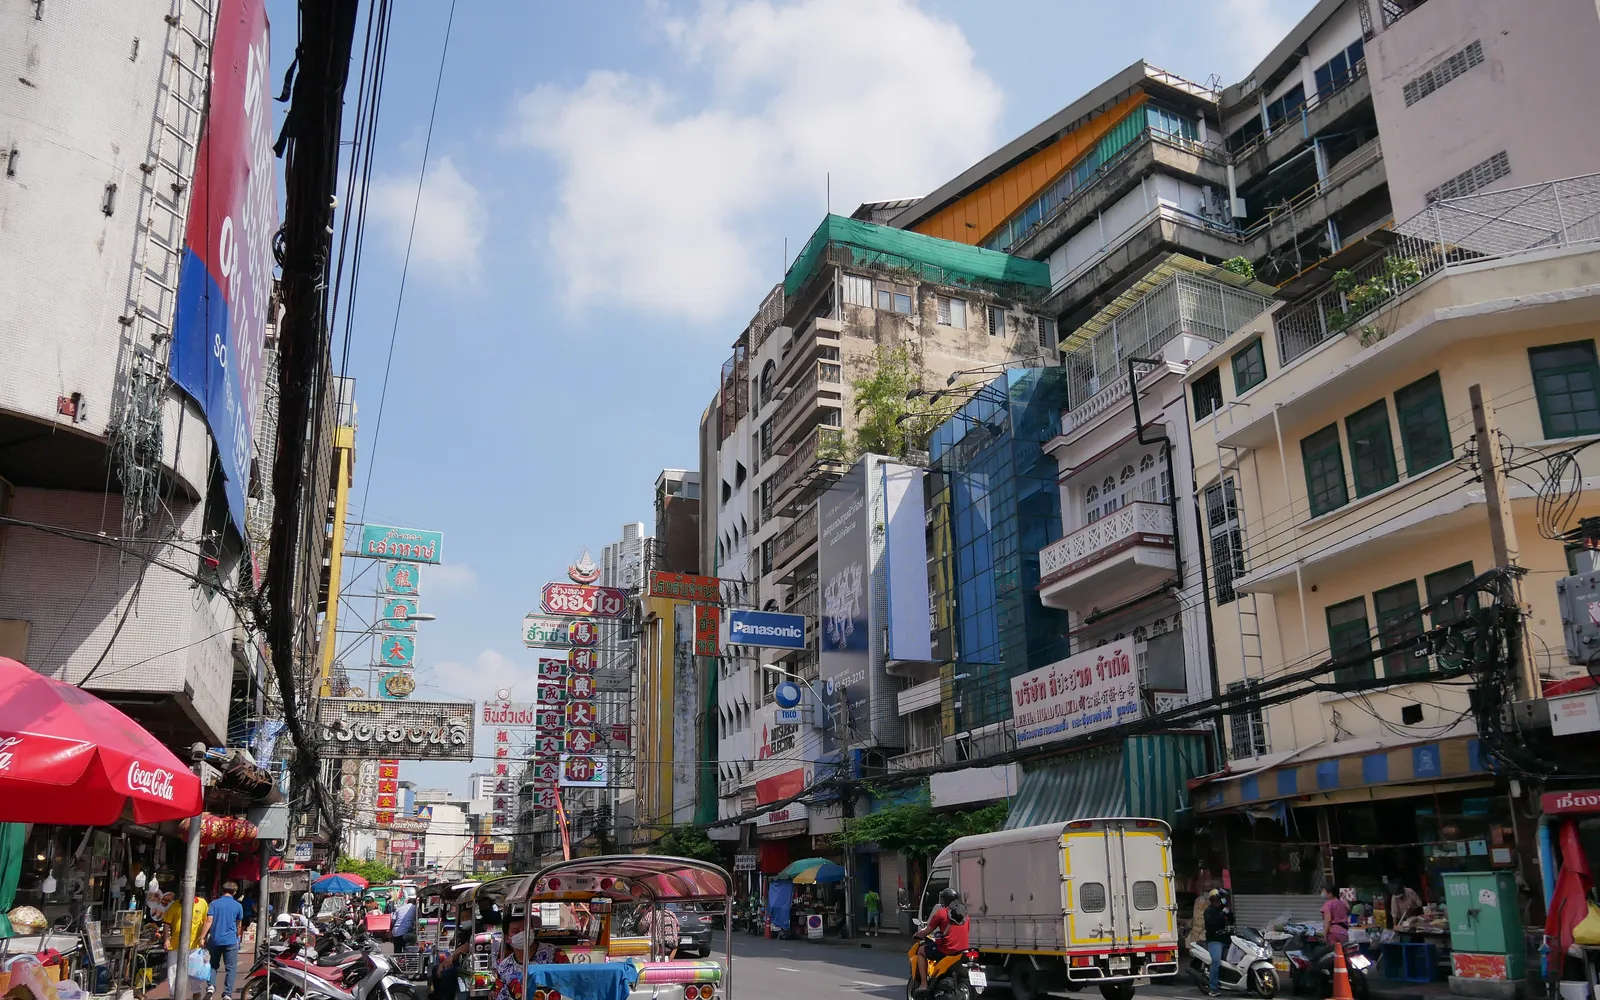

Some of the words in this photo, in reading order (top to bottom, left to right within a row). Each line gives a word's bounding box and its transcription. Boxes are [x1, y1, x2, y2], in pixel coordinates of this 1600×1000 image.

[651, 572, 719, 599] โรงรับจำนำ
[549, 590, 620, 613] ทองใบ
[733, 620, 802, 638] Panasonic
[1015, 676, 1047, 706] บริษัท
[1096, 649, 1130, 681] จำกัด
